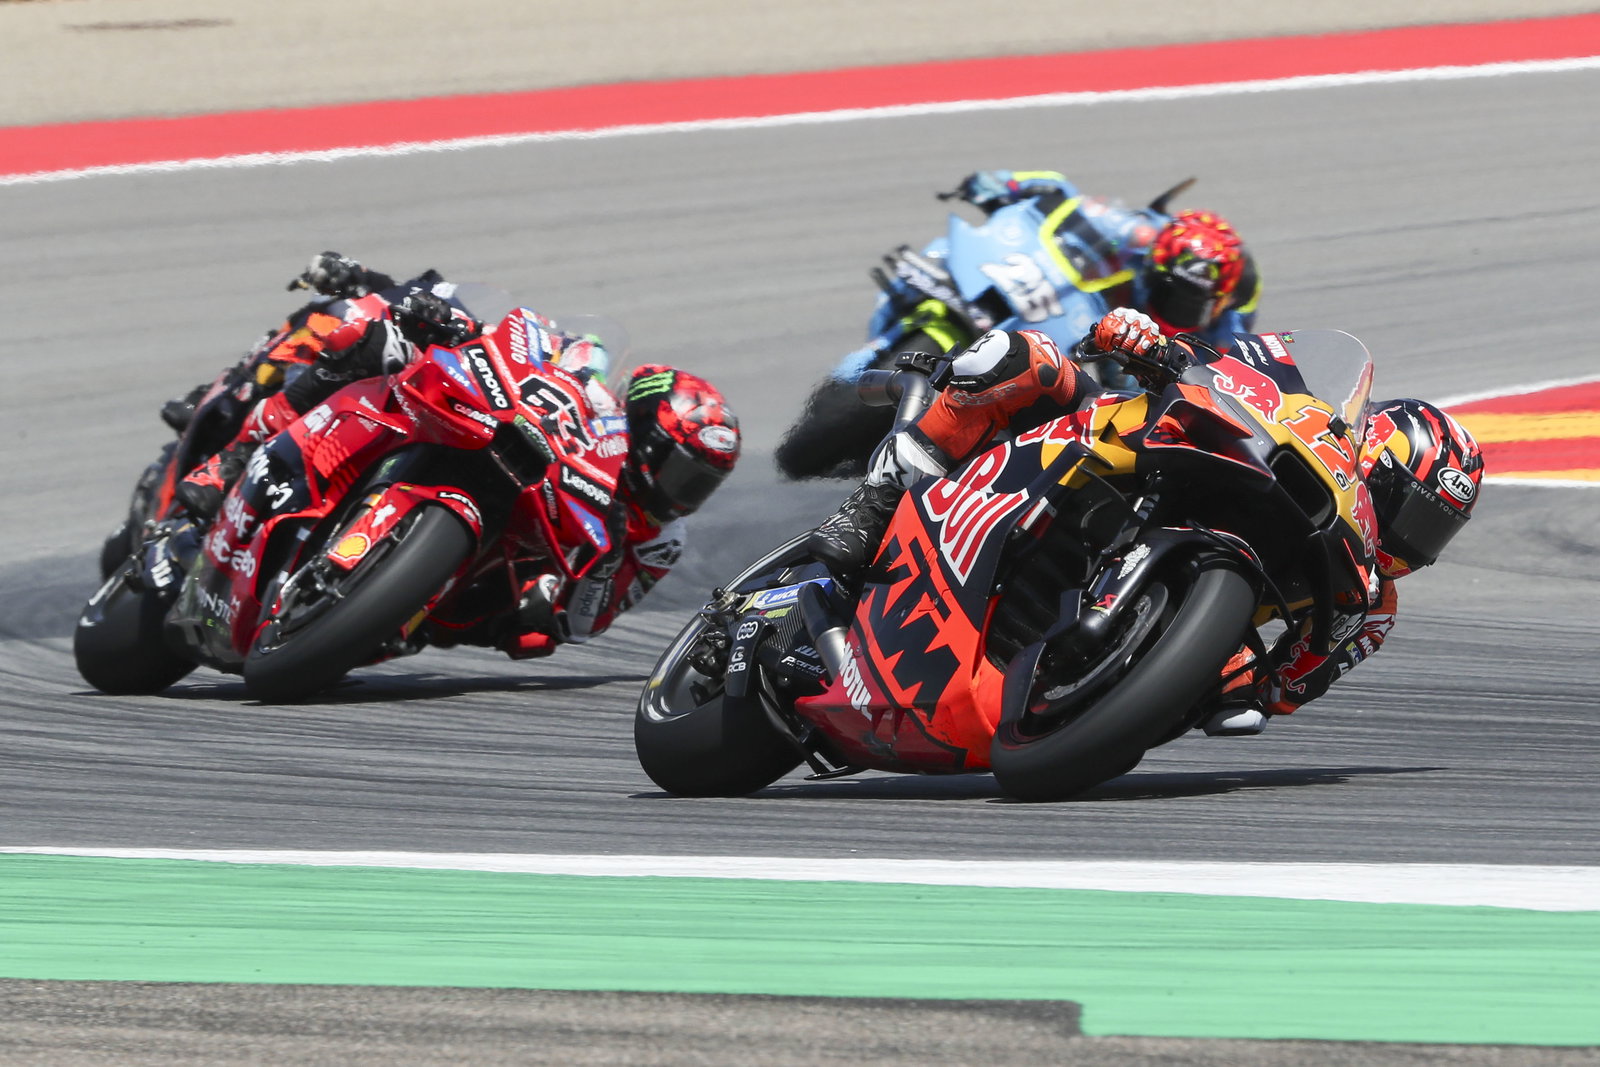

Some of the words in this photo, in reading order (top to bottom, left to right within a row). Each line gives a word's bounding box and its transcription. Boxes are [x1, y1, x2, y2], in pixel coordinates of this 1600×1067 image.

[1261, 335, 1288, 359] MOTUL
[447, 366, 471, 388] TIM
[468, 348, 508, 409] Lenovo
[1280, 405, 1356, 491] 12
[562, 465, 612, 506] Lenovo
[1410, 481, 1436, 502] GIVES
[1439, 501, 1454, 516] YOU
[1441, 474, 1473, 498] Arai
[727, 661, 747, 674] RCB
[838, 641, 873, 722] MOTUL
